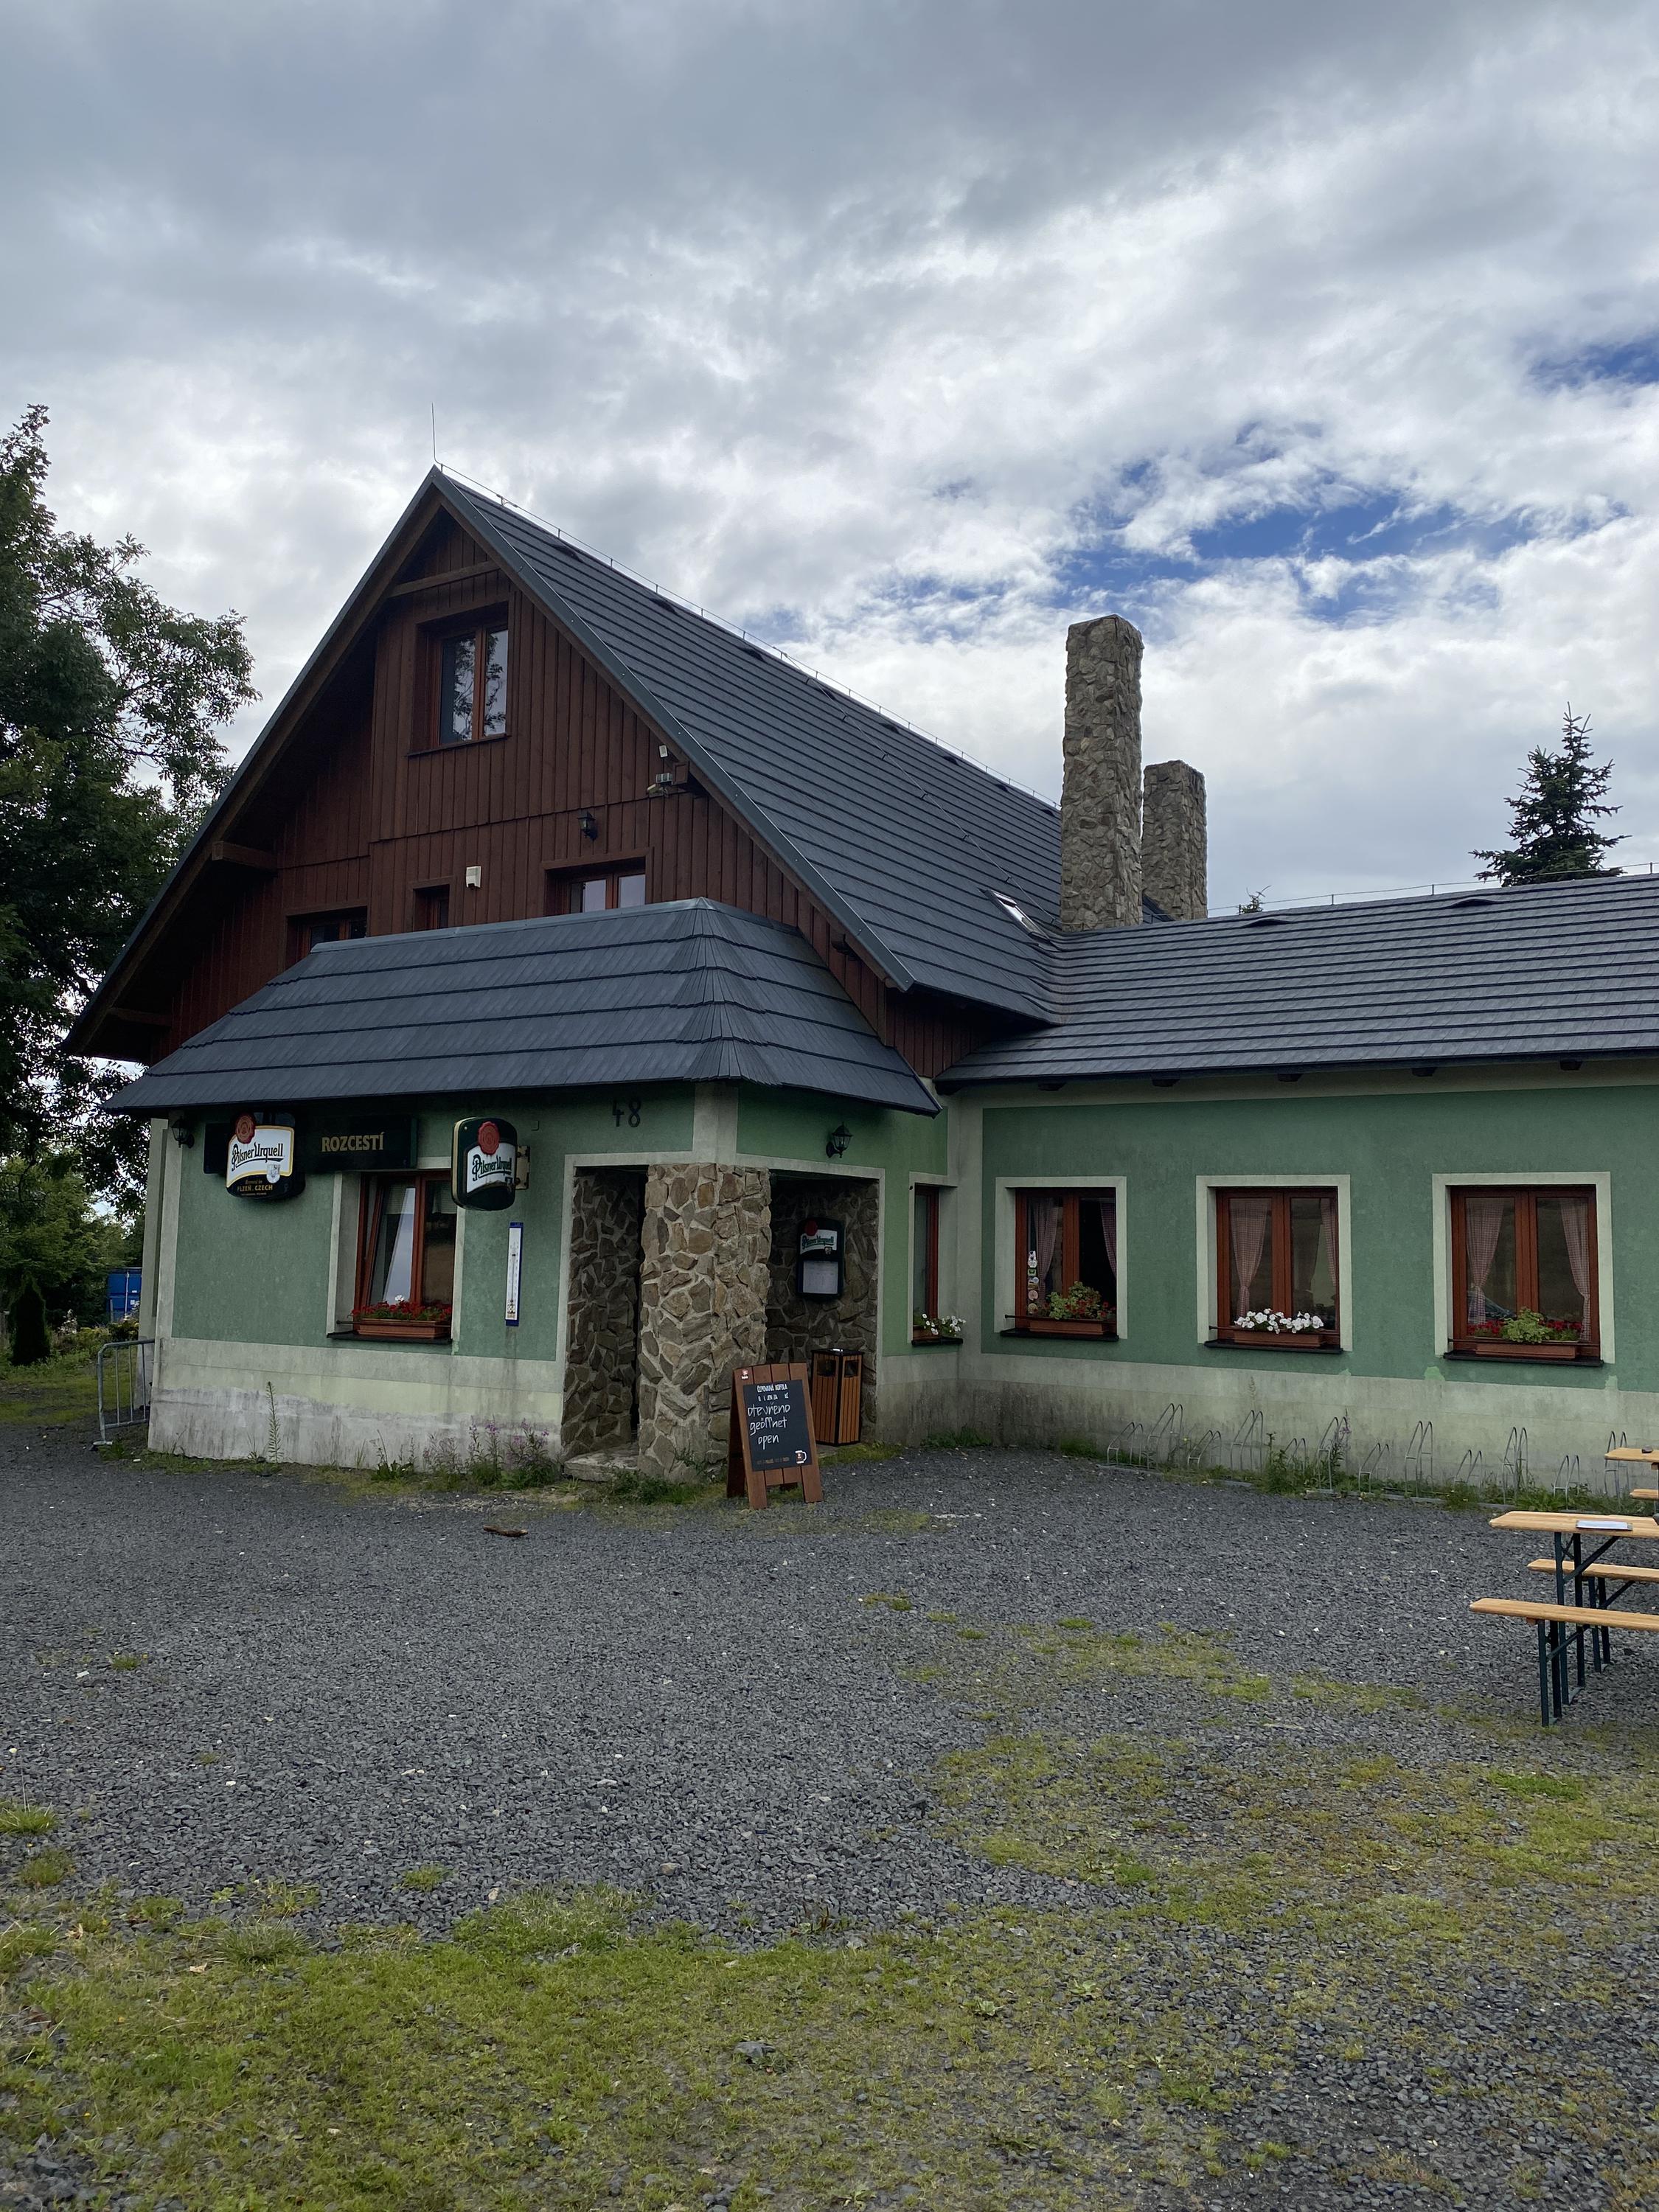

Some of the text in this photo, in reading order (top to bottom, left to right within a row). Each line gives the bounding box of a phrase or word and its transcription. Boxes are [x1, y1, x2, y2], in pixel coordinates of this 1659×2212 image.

[613, 1098, 641, 1127] 48
[321, 1131, 385, 1152] ROZCESTÍ
[232, 1141, 284, 1172] Pilsner Urquell
[472, 1154, 497, 1181] Pilsner
[748, 1402, 790, 1417] otevřeno
[750, 1416, 787, 1436] geöffnet
[758, 1434, 779, 1450] open
